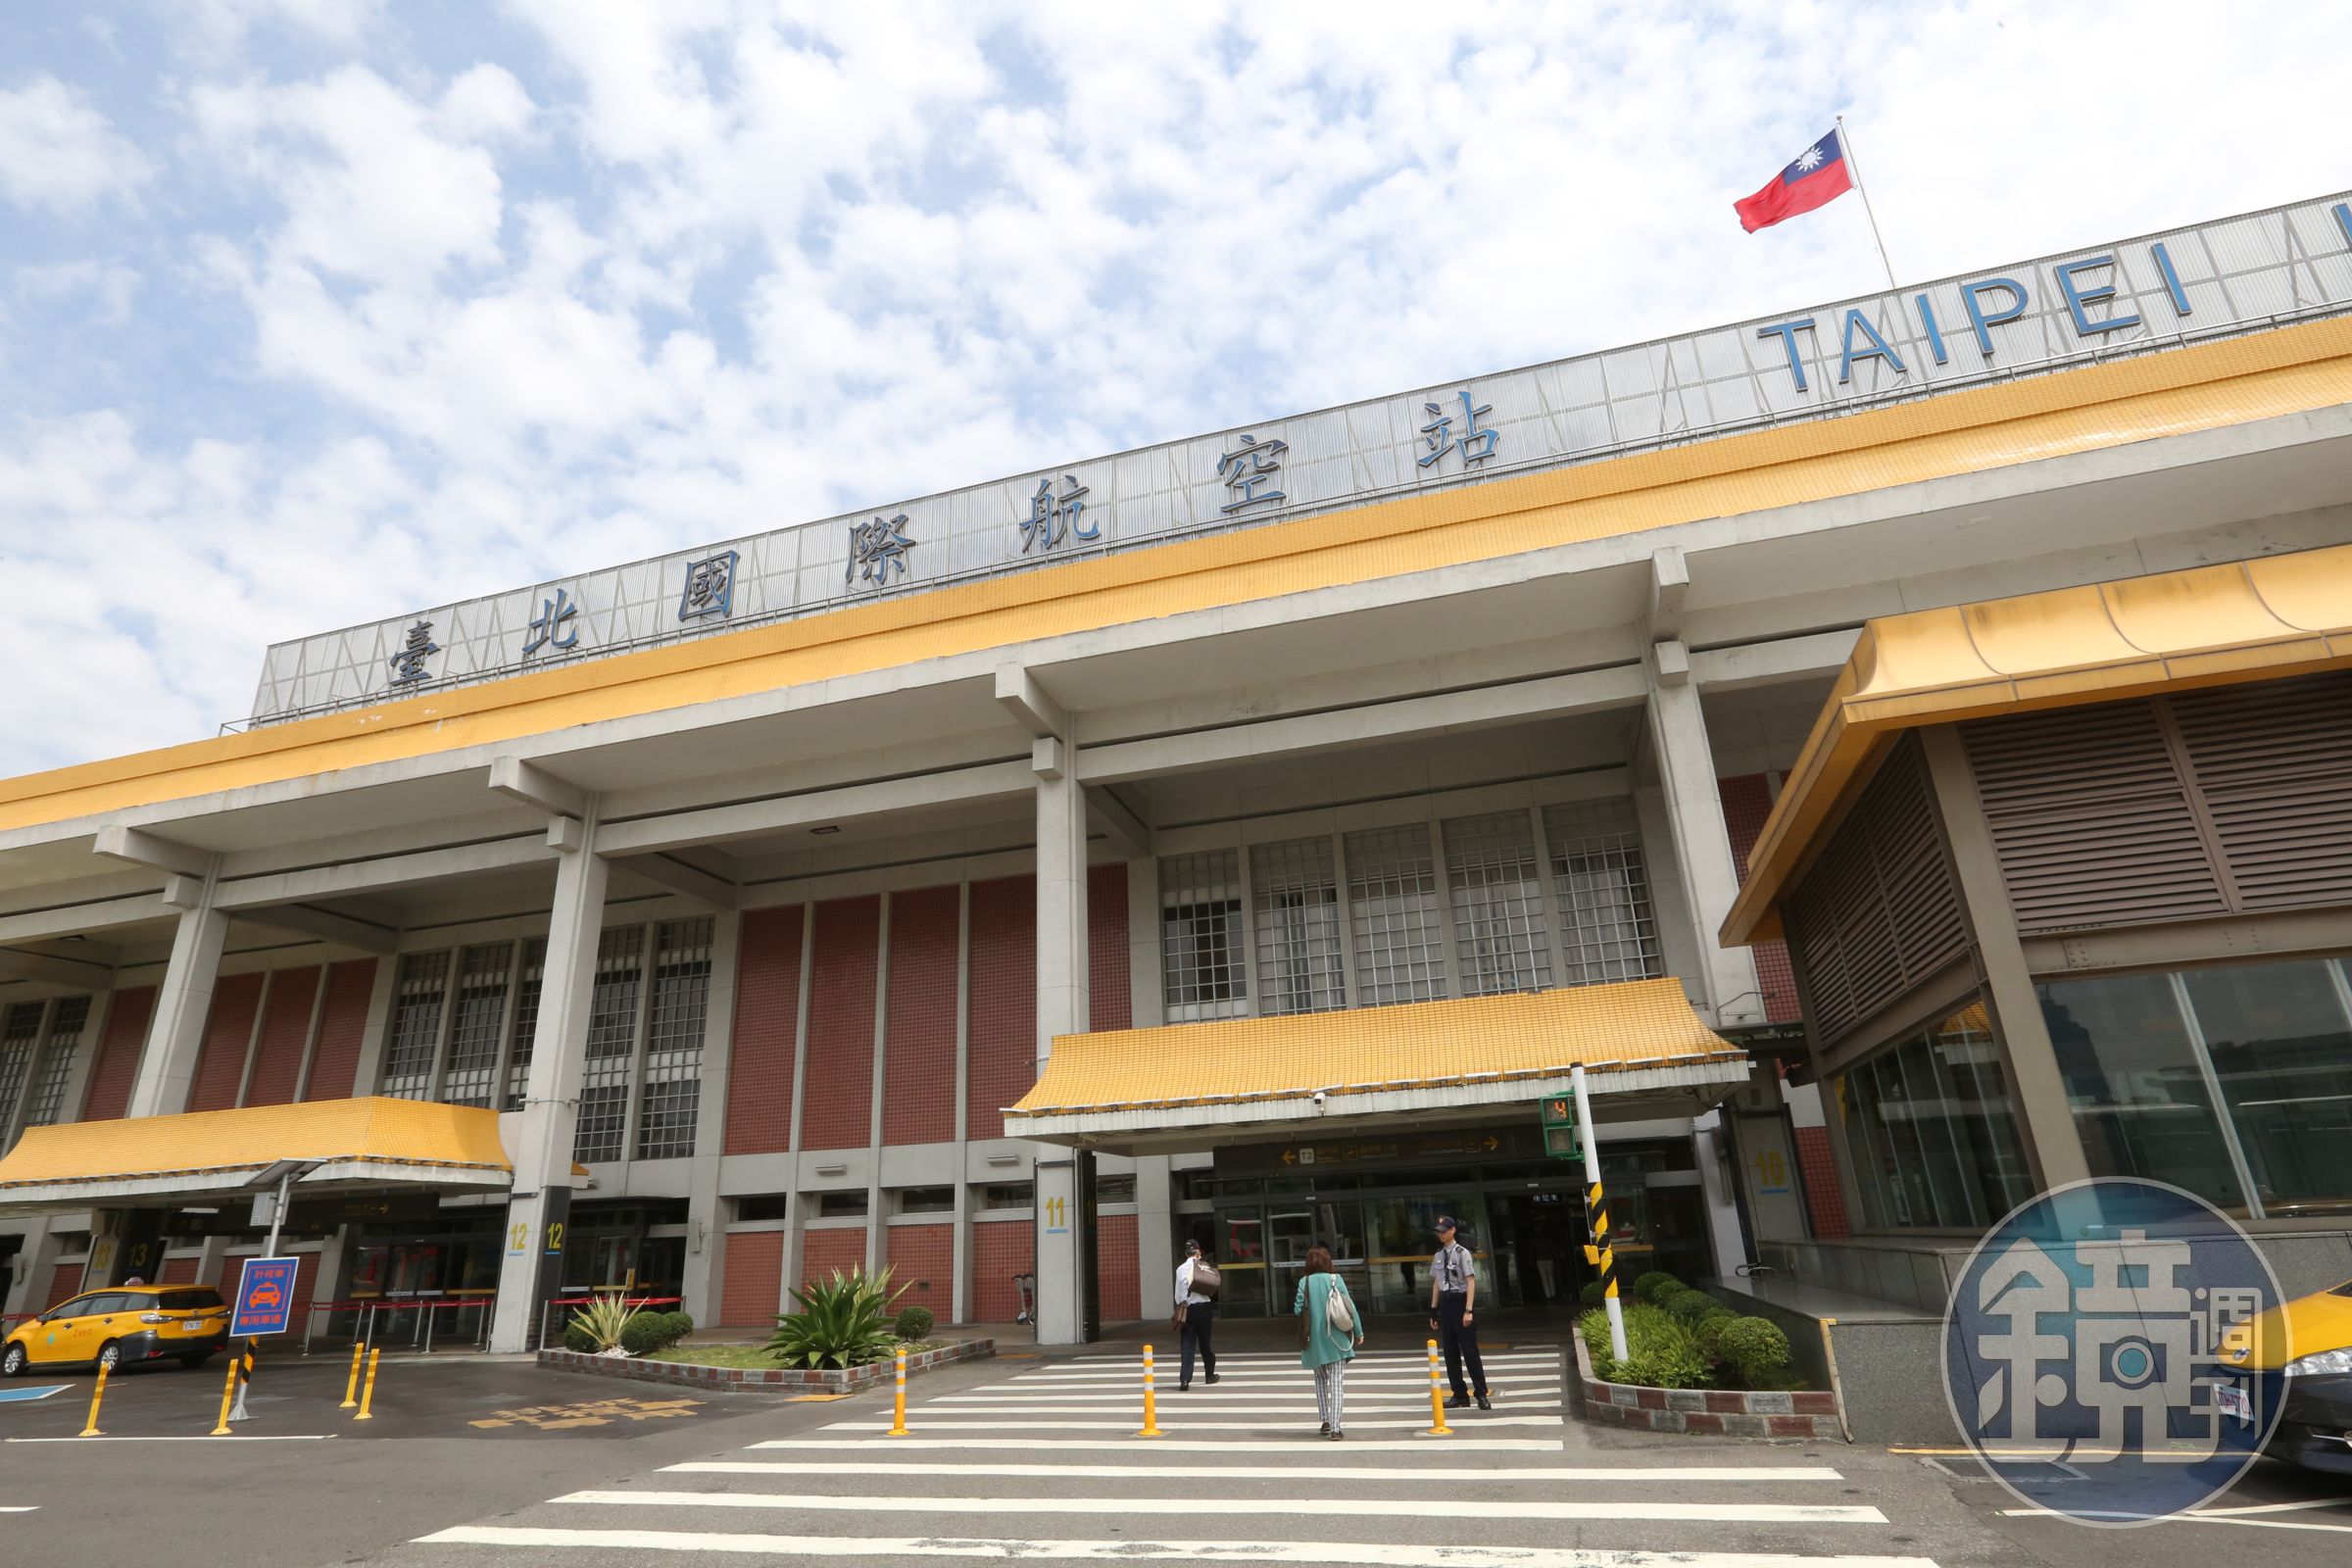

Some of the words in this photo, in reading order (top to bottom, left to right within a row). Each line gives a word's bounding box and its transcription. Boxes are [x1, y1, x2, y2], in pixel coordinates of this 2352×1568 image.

[1757, 242, 2192, 393] TAIPEI
[390, 391, 1499, 686] 臺北國際航空站
[1755, 1149, 1786, 1187] 10
[1047, 1197, 1064, 1227] 11
[511, 1222, 527, 1250] 12
[548, 1222, 564, 1250] 12
[126, 1242, 149, 1267] 13
